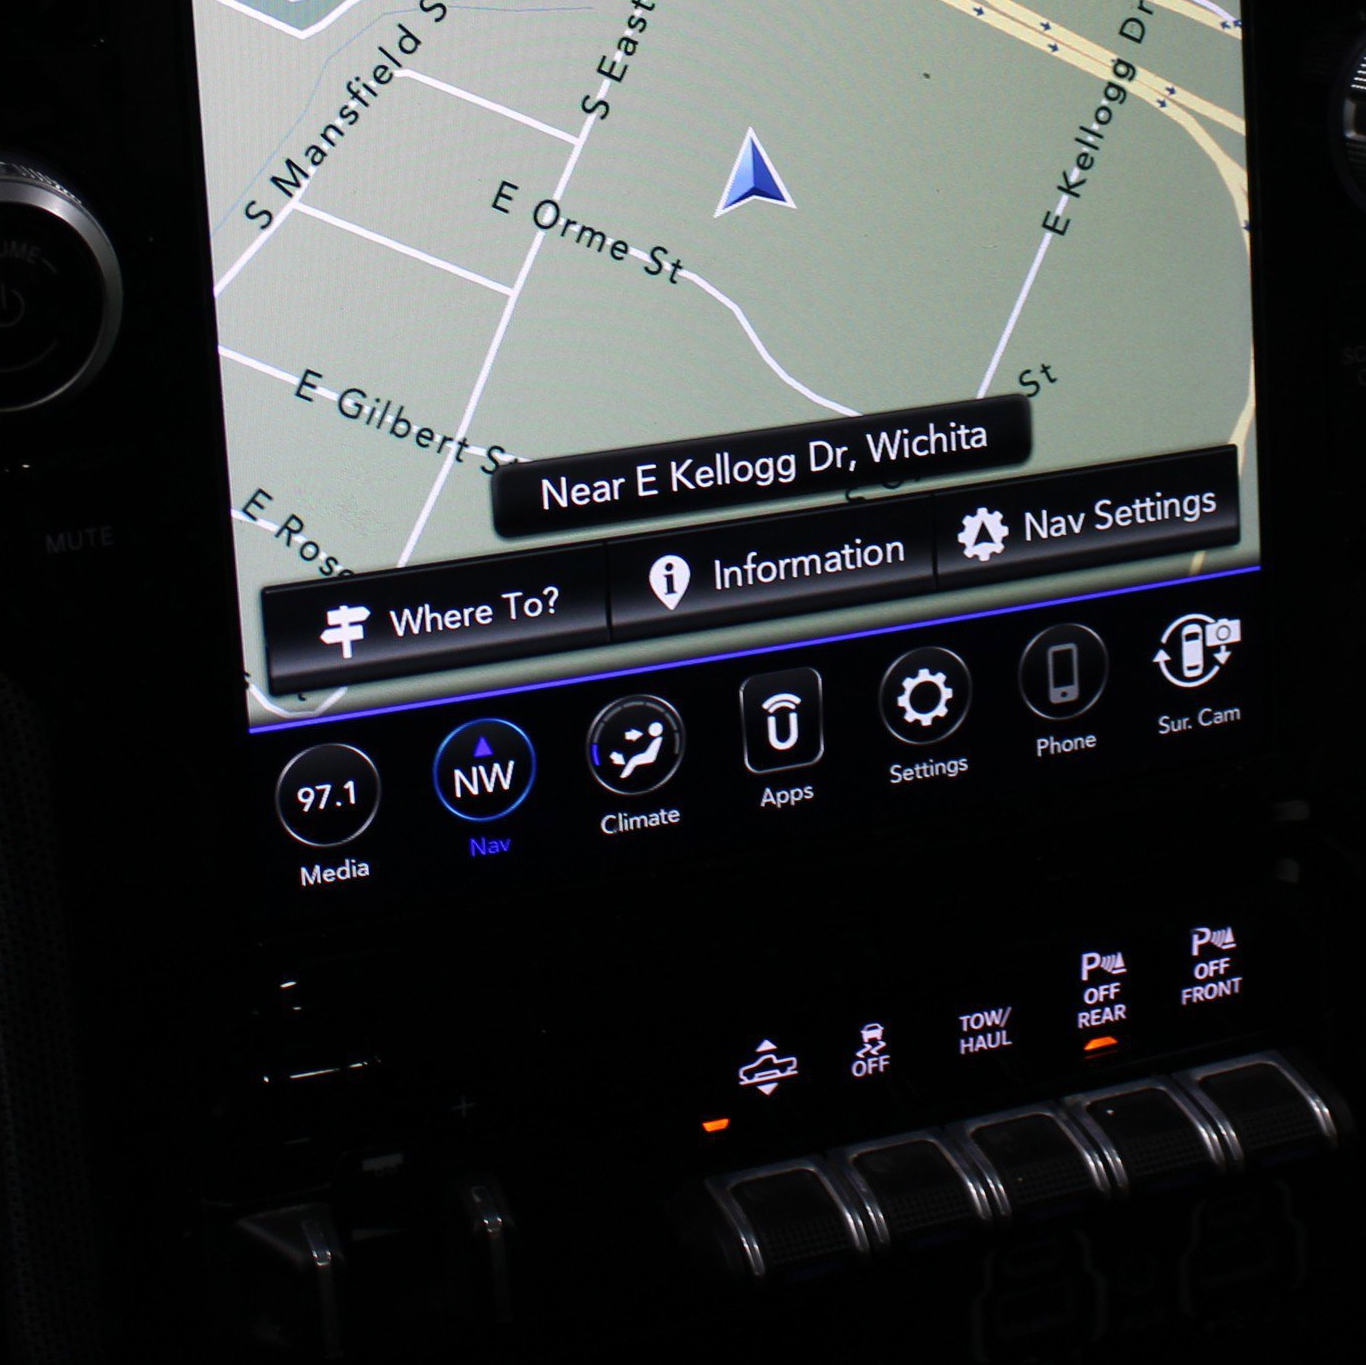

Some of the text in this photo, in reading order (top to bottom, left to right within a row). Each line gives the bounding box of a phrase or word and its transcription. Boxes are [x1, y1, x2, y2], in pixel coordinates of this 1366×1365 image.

[580, 93, 611, 121] S
[244, 199, 275, 230] S
[269, 22, 424, 200] Mansfield
[1041, 209, 1073, 237] E
[1057, 57, 1137, 200] Kellogg
[491, 179, 686, 285] E Orme St
[1018, 363, 1058, 398] St
[293, 367, 519, 475] E Gilbert S
[540, 475, 626, 511] Near
[635, 465, 658, 498] E
[670, 449, 797, 495] Kellogg
[808, 438, 857, 473] Dr,
[865, 421, 989, 463] Wichita
[240, 487, 274, 522] E
[1024, 489, 1218, 543] Nav Settings
[44, 525, 115, 555] MUTE
[713, 538, 906, 591] Information
[390, 585, 561, 639] Where To?
[1157, 704, 1241, 736] Sur. Cam
[1036, 732, 1098, 758] Phone
[453, 759, 516, 799] NW
[889, 753, 970, 784] Settings
[296, 780, 357, 813] 97.1
[757, 784, 815, 809] Apps
[600, 806, 681, 836] Climate
[469, 837, 511, 857] Nav
[300, 857, 370, 887] Media
[1193, 957, 1231, 981] OFF
[1083, 981, 1121, 1004] OFF
[1180, 976, 1243, 1005] FRONT
[958, 1005, 1013, 1032] TOW/
[1077, 1003, 1127, 1029] REAR
[958, 1030, 1013, 1055] HAUL
[851, 1053, 891, 1078] OFF
